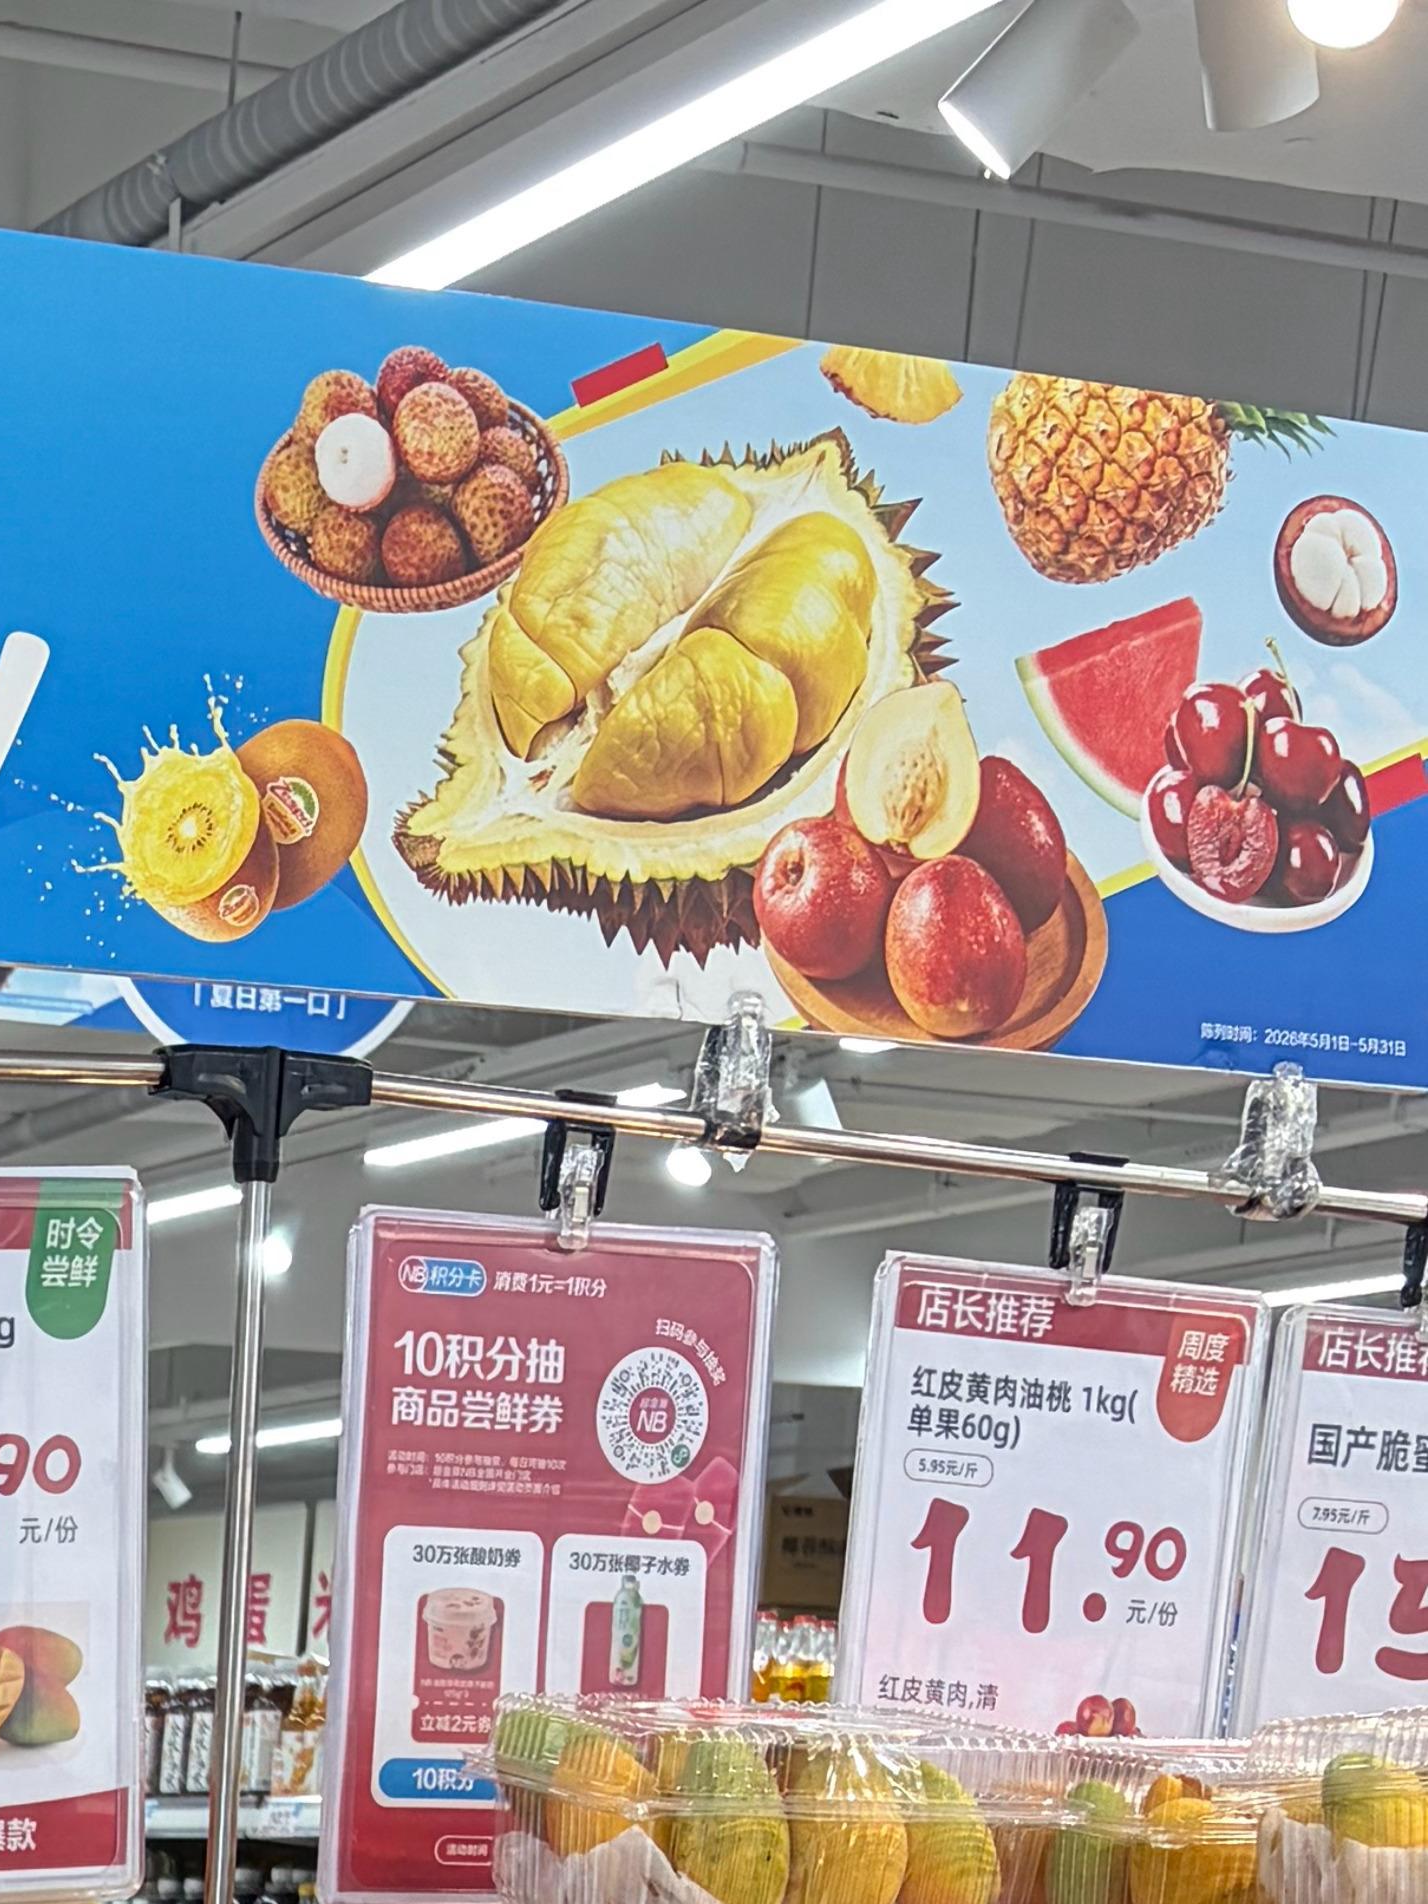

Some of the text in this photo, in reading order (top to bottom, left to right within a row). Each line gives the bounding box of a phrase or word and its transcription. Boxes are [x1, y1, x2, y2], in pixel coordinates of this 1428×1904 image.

[45, 1216, 104, 1249] 时令
[40, 1254, 99, 1288] 尝鲜
[429, 1265, 482, 1289] 积分卡
[917, 1287, 1055, 1338] 店长推荐
[394, 1330, 565, 1384] 10积分抽
[1177, 1330, 1230, 1362] 周度
[1318, 1327, 1428, 1376] 店长推
[910, 1365, 1073, 1413] 红皮黄肉油桃
[1170, 1364, 1221, 1397] 精选
[391, 1386, 564, 1434] 商品尝鲜券
[636, 1410, 669, 1432] NB
[18, 1516, 79, 1544] 元/份
[1126, 1599, 1179, 1628] 元/份
